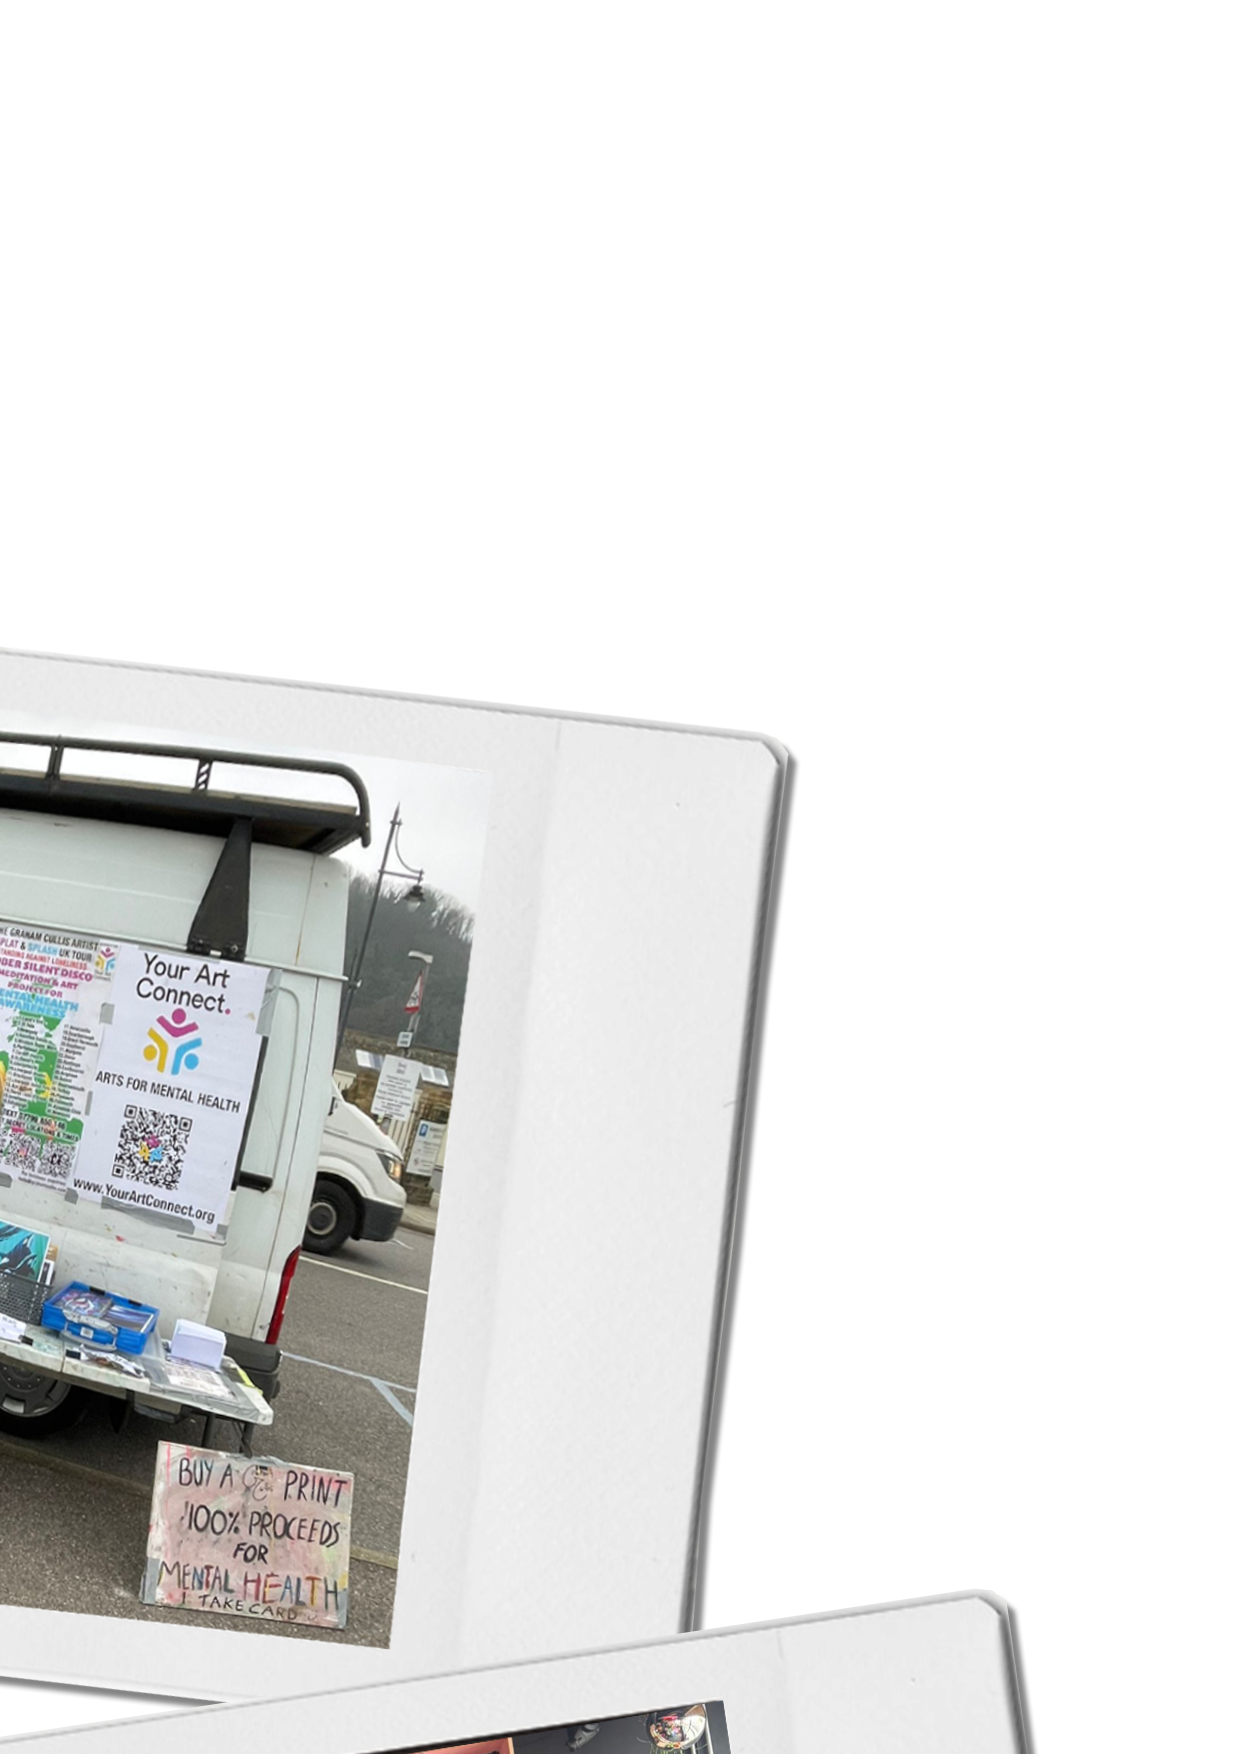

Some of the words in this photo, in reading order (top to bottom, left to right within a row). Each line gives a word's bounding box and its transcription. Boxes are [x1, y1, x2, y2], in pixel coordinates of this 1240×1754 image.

[10, 928, 42, 942] GRAHAM
[43, 933, 71, 946] CULLIS
[71, 937, 99, 951] ARTIST
[20, 941, 26, 950] &
[27, 942, 58, 956] SPLASH
[59, 947, 71, 958] UK
[71, 949, 92, 962] TOUR
[25, 952, 51, 963] AGAINST
[23, 961, 60, 975] SILENT
[61, 968, 93, 982] DISCO
[143, 952, 190, 982] Your
[194, 963, 231, 989] Art
[7, 981, 44, 996] PROJECT
[44, 987, 63, 998] FOR
[60, 980, 79, 991] ART
[136, 977, 231, 1016] Connect.
[36, 993, 79, 1012] HEALTH
[95, 1070, 124, 1088] ARTS
[126, 1077, 148, 1093] FOR
[149, 1082, 194, 1104] MENTAL
[197, 1093, 241, 1113] HEALTH
[72, 1176, 216, 1225] www.YourArtConnect.org
[179, 1457, 214, 1487] BUY
[219, 1463, 234, 1489] A
[283, 1469, 348, 1508] PRINT
[187, 1503, 241, 1536] 100%
[248, 1510, 341, 1548] PROCEEDS
[232, 1542, 269, 1564] FOR
[157, 1561, 235, 1594] MENTAL
[243, 1571, 340, 1611] HEALTH
[198, 1594, 245, 1612] TAKE
[249, 1603, 298, 1621] CARD
